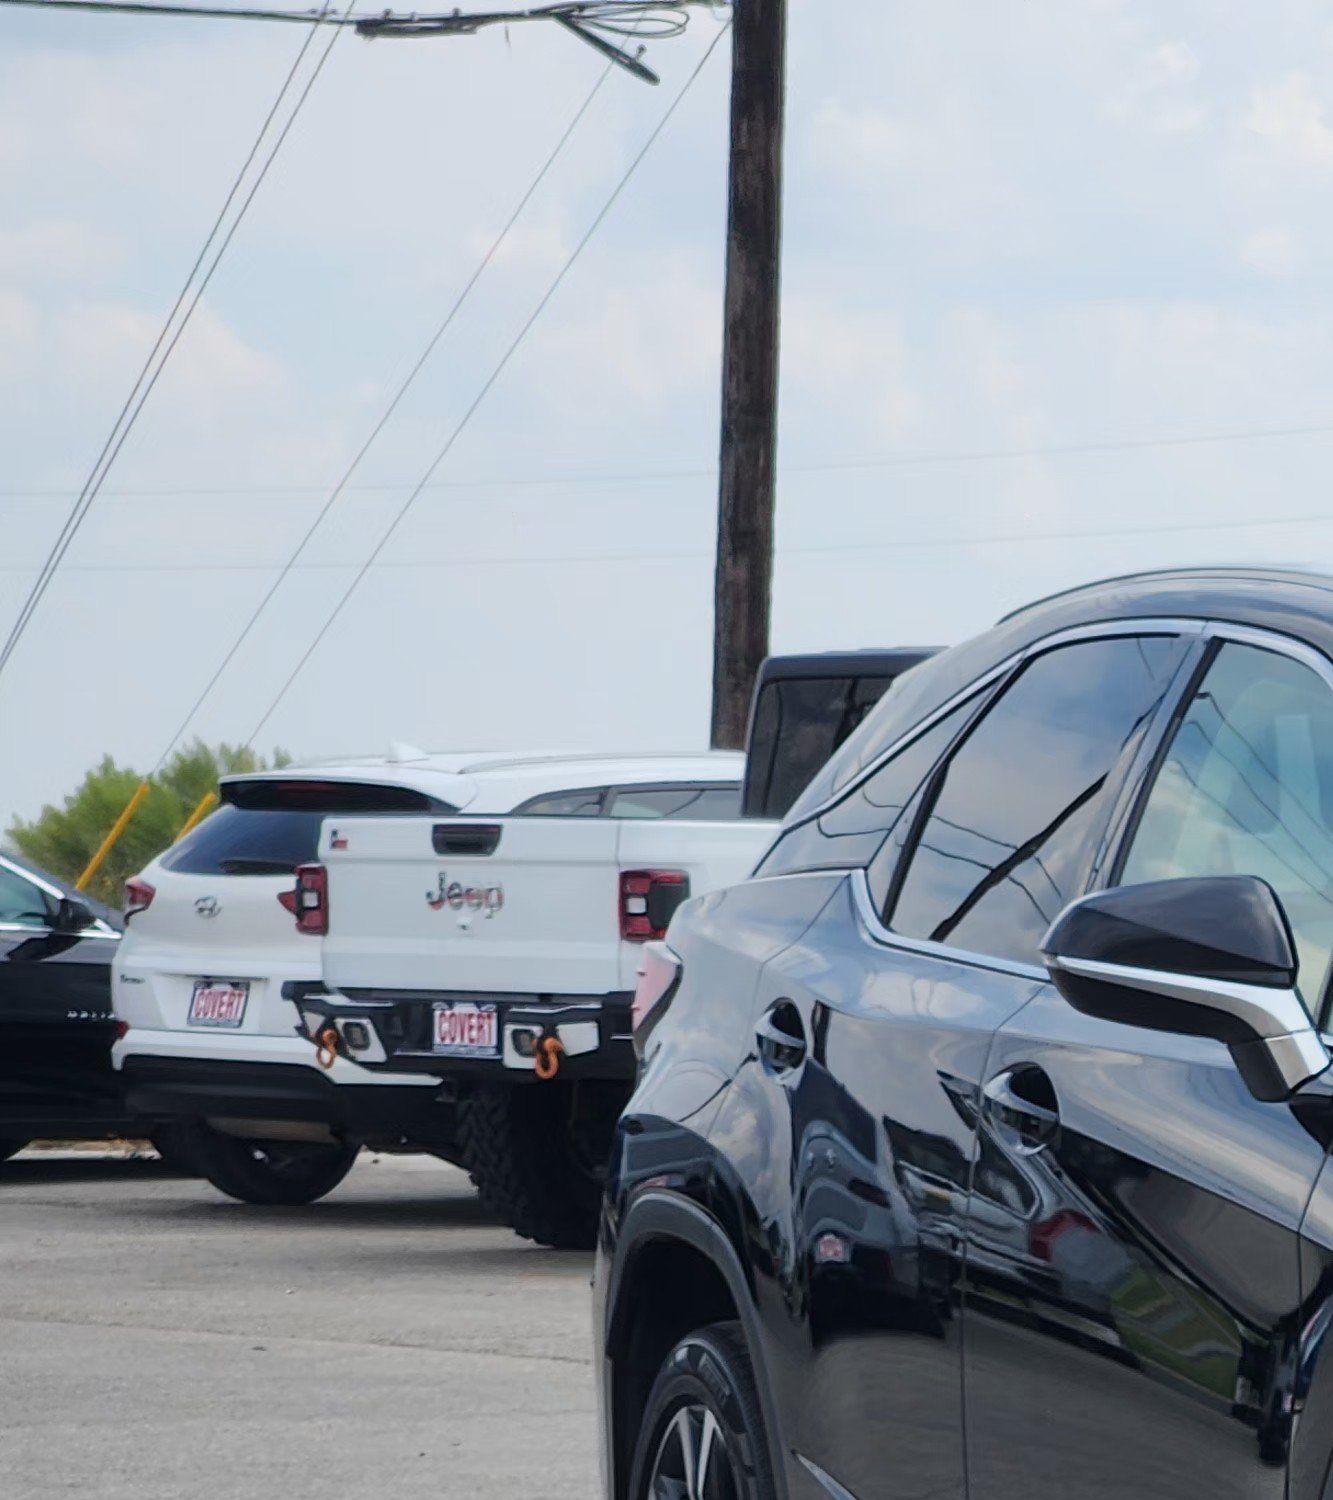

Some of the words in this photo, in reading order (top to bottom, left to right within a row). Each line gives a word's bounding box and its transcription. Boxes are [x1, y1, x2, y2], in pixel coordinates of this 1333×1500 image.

[425, 871, 505, 919] Jeep
[194, 990, 244, 1019] COVERT
[437, 1011, 496, 1045] COVERT
